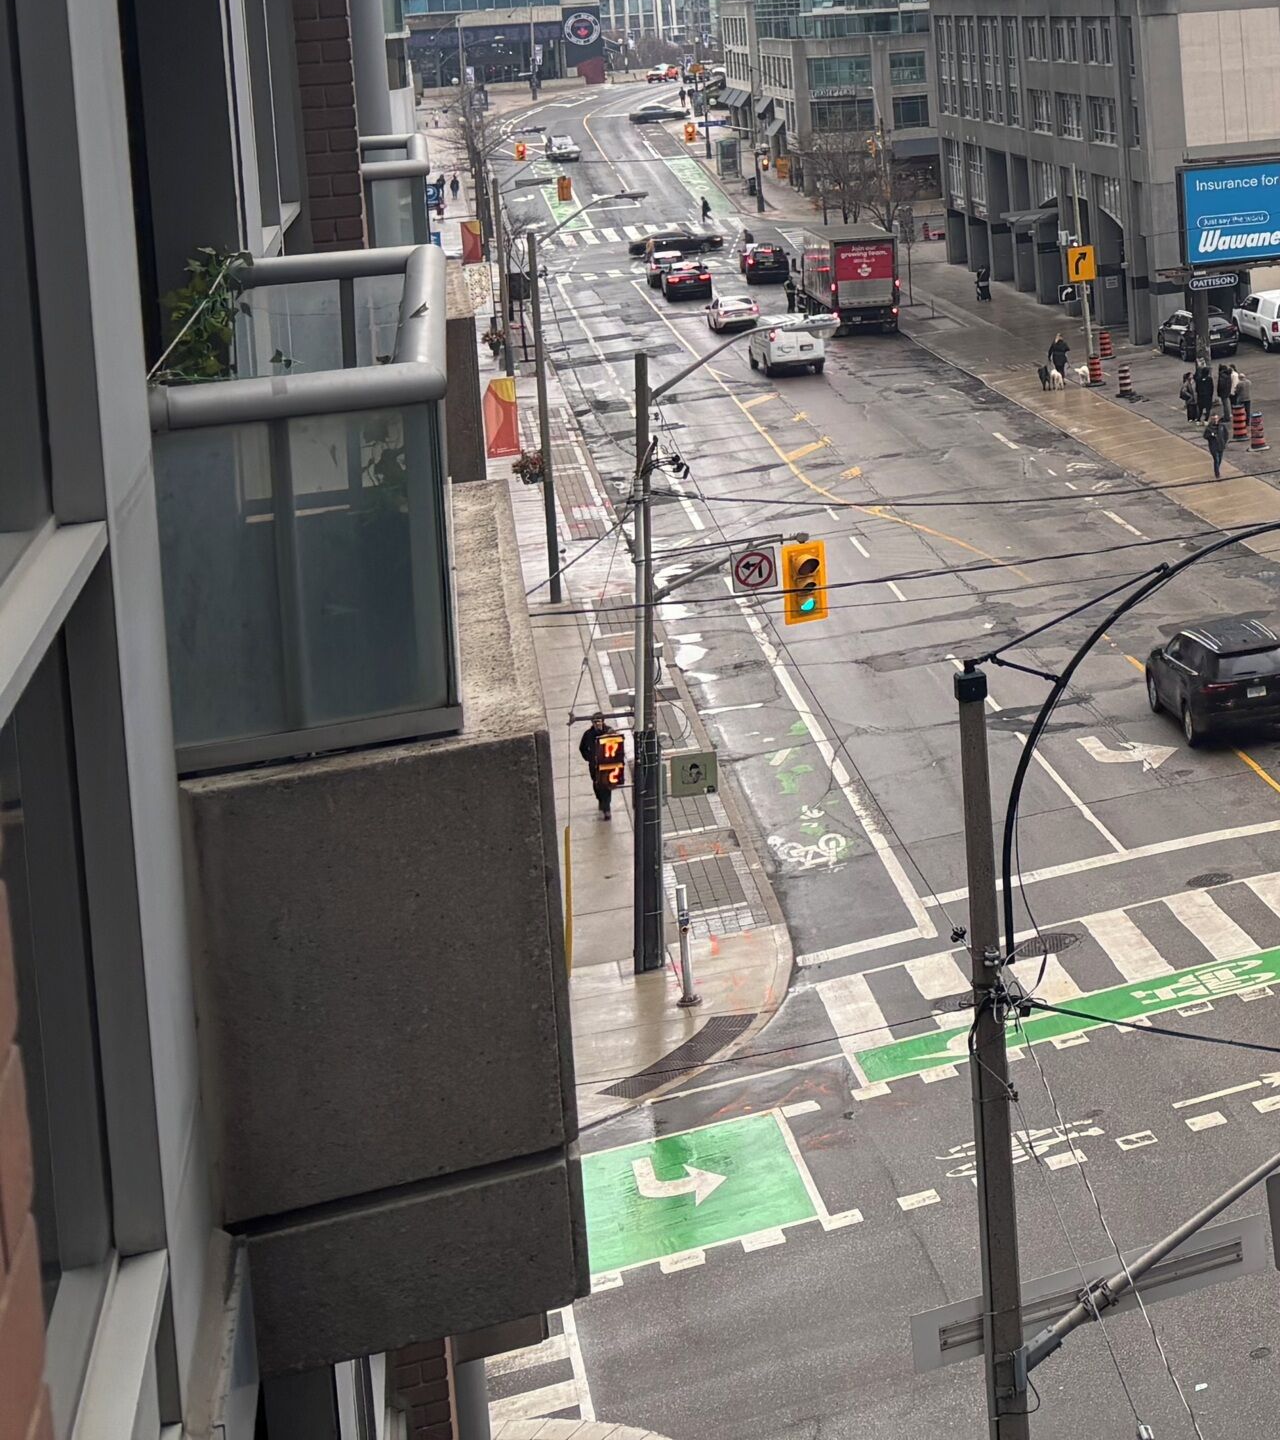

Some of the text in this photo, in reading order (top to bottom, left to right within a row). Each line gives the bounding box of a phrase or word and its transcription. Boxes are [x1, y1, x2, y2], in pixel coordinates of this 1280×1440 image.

[1196, 176, 1258, 191] Insurance
[1261, 174, 1280, 186] for
[1193, 275, 1235, 288] PATTISON
